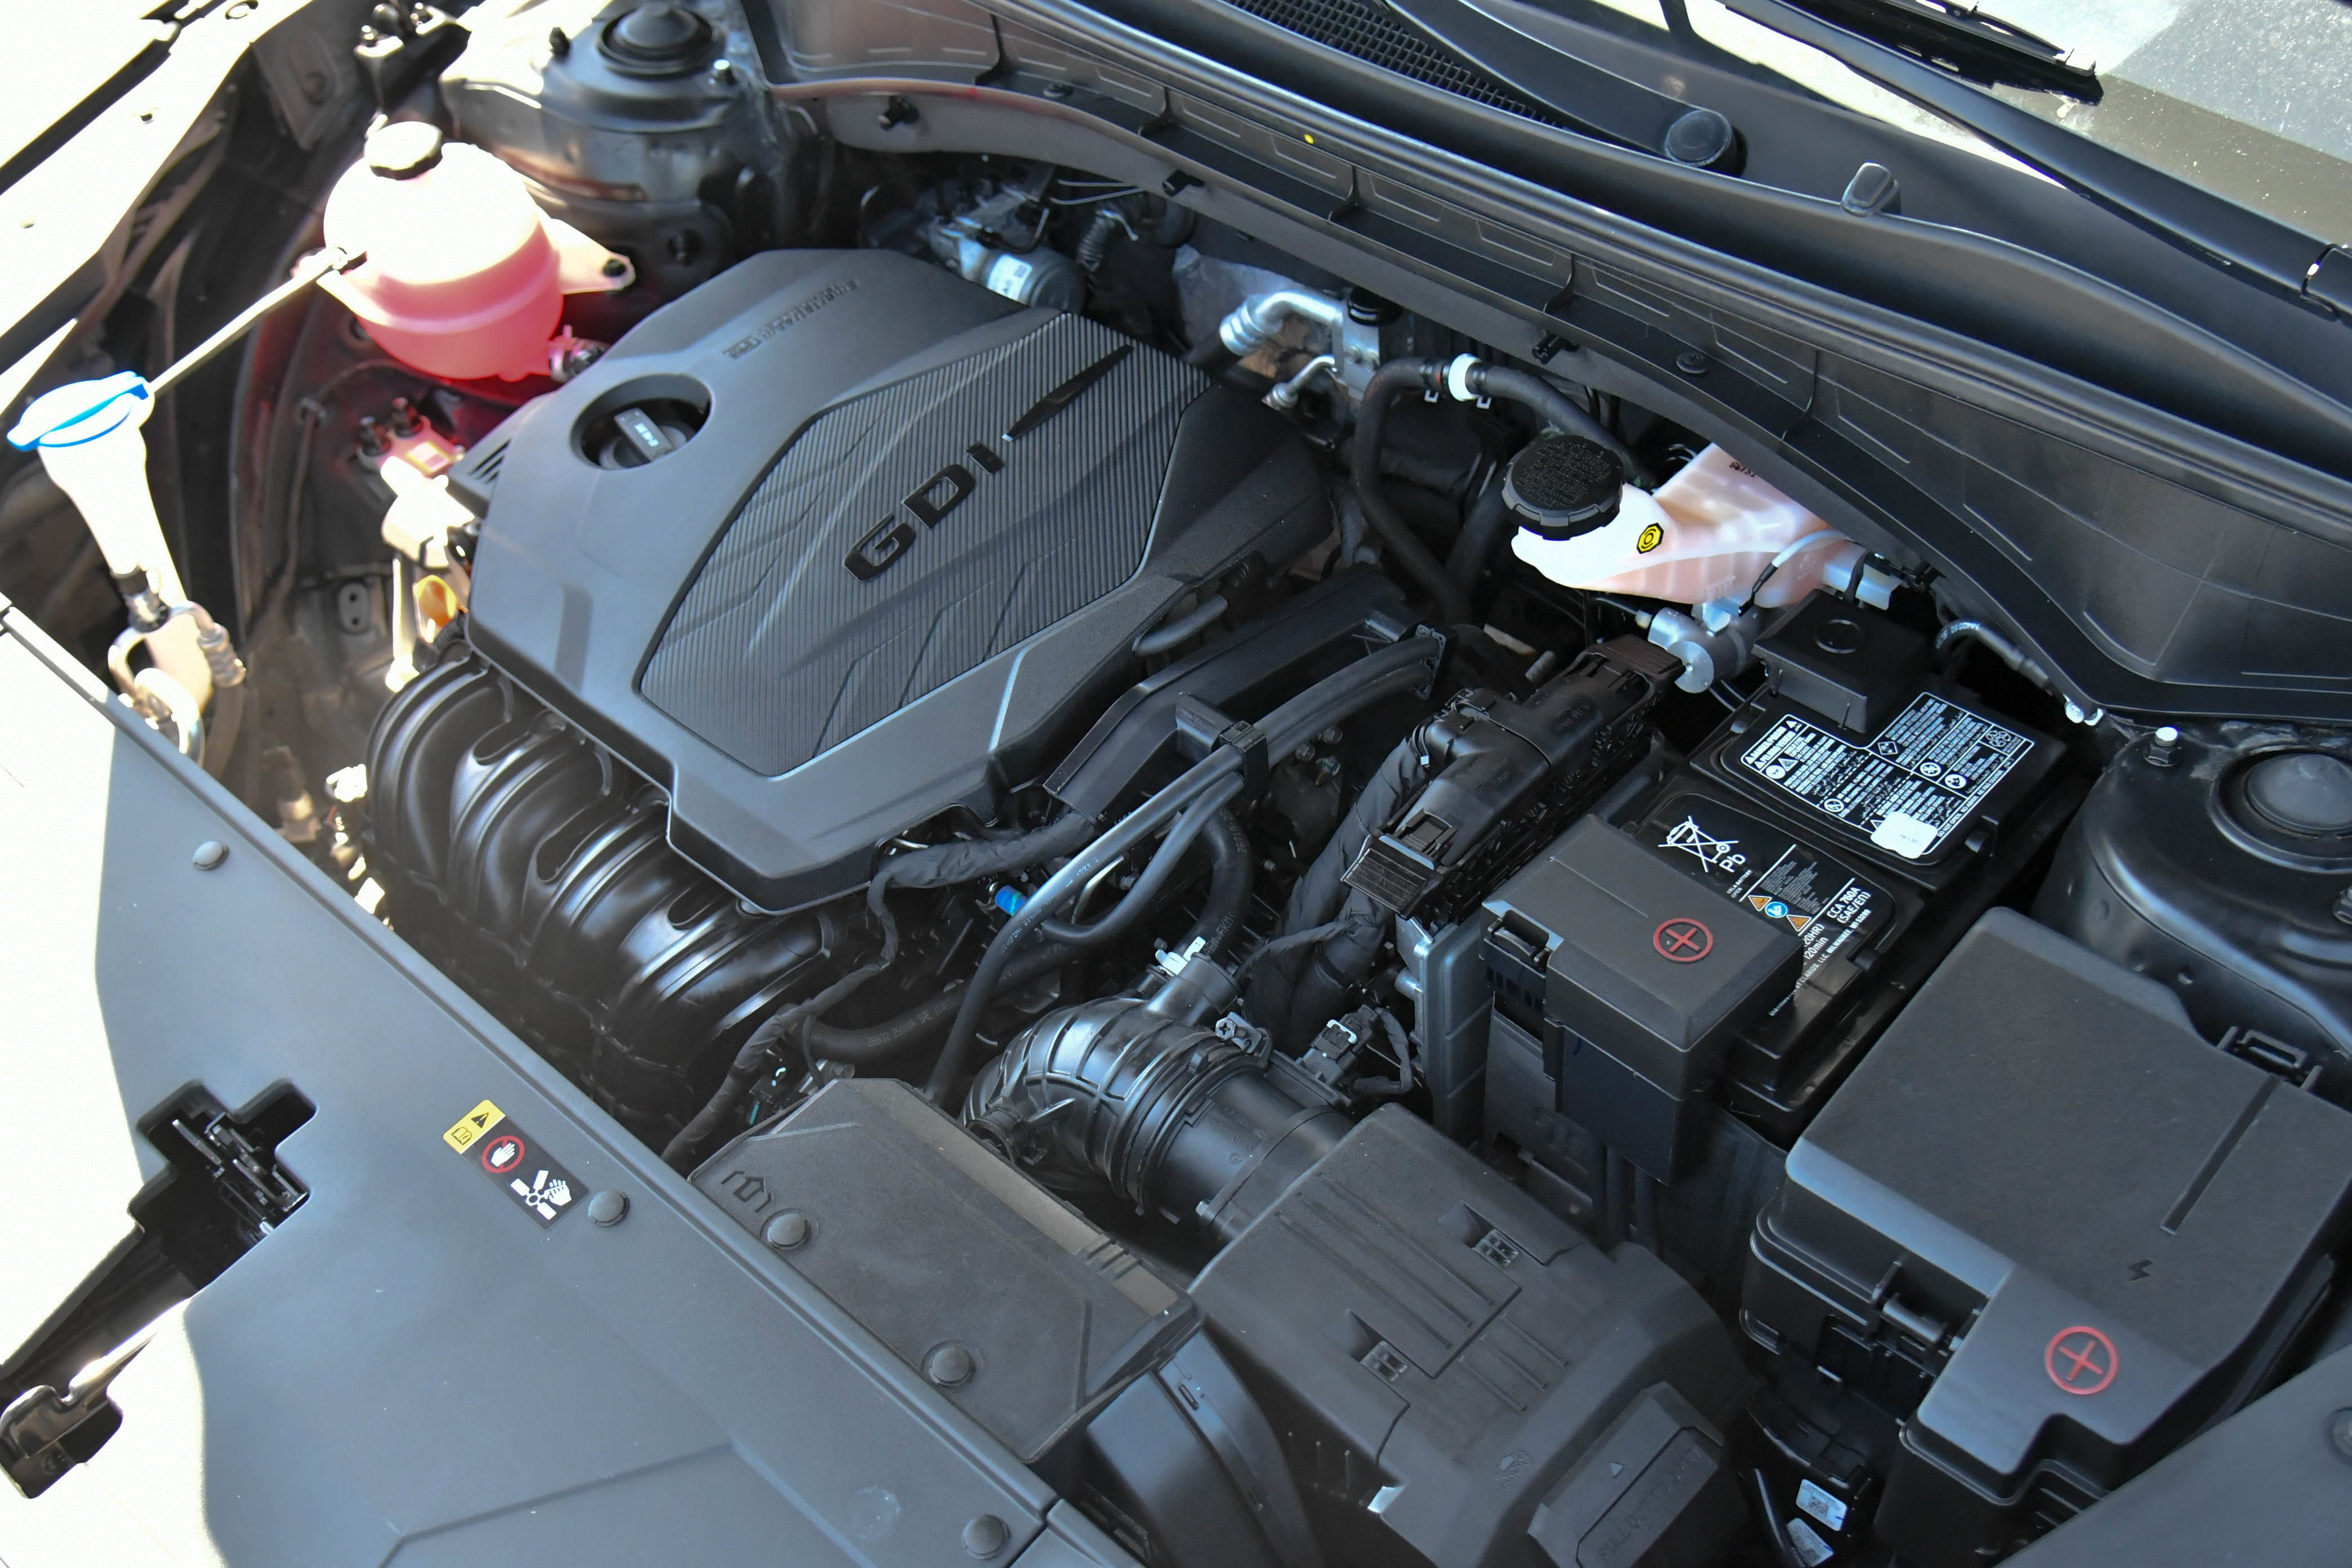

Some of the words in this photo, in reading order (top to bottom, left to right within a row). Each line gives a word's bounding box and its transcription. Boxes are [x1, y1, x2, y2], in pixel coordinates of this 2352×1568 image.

[1941, 822, 1954, 832] NOT
[1981, 782, 1992, 791] PAS
[1719, 854, 1745, 872] Pb
[1735, 870, 1753, 885] BATTERY
[1731, 887, 1743, 898] OPEN
[1827, 903, 1845, 919] CCA
[1839, 887, 1861, 904] 760A
[1850, 920, 1858, 929] WI
[1857, 910, 1871, 923] 53209
[1804, 937, 1828, 959] 120min
